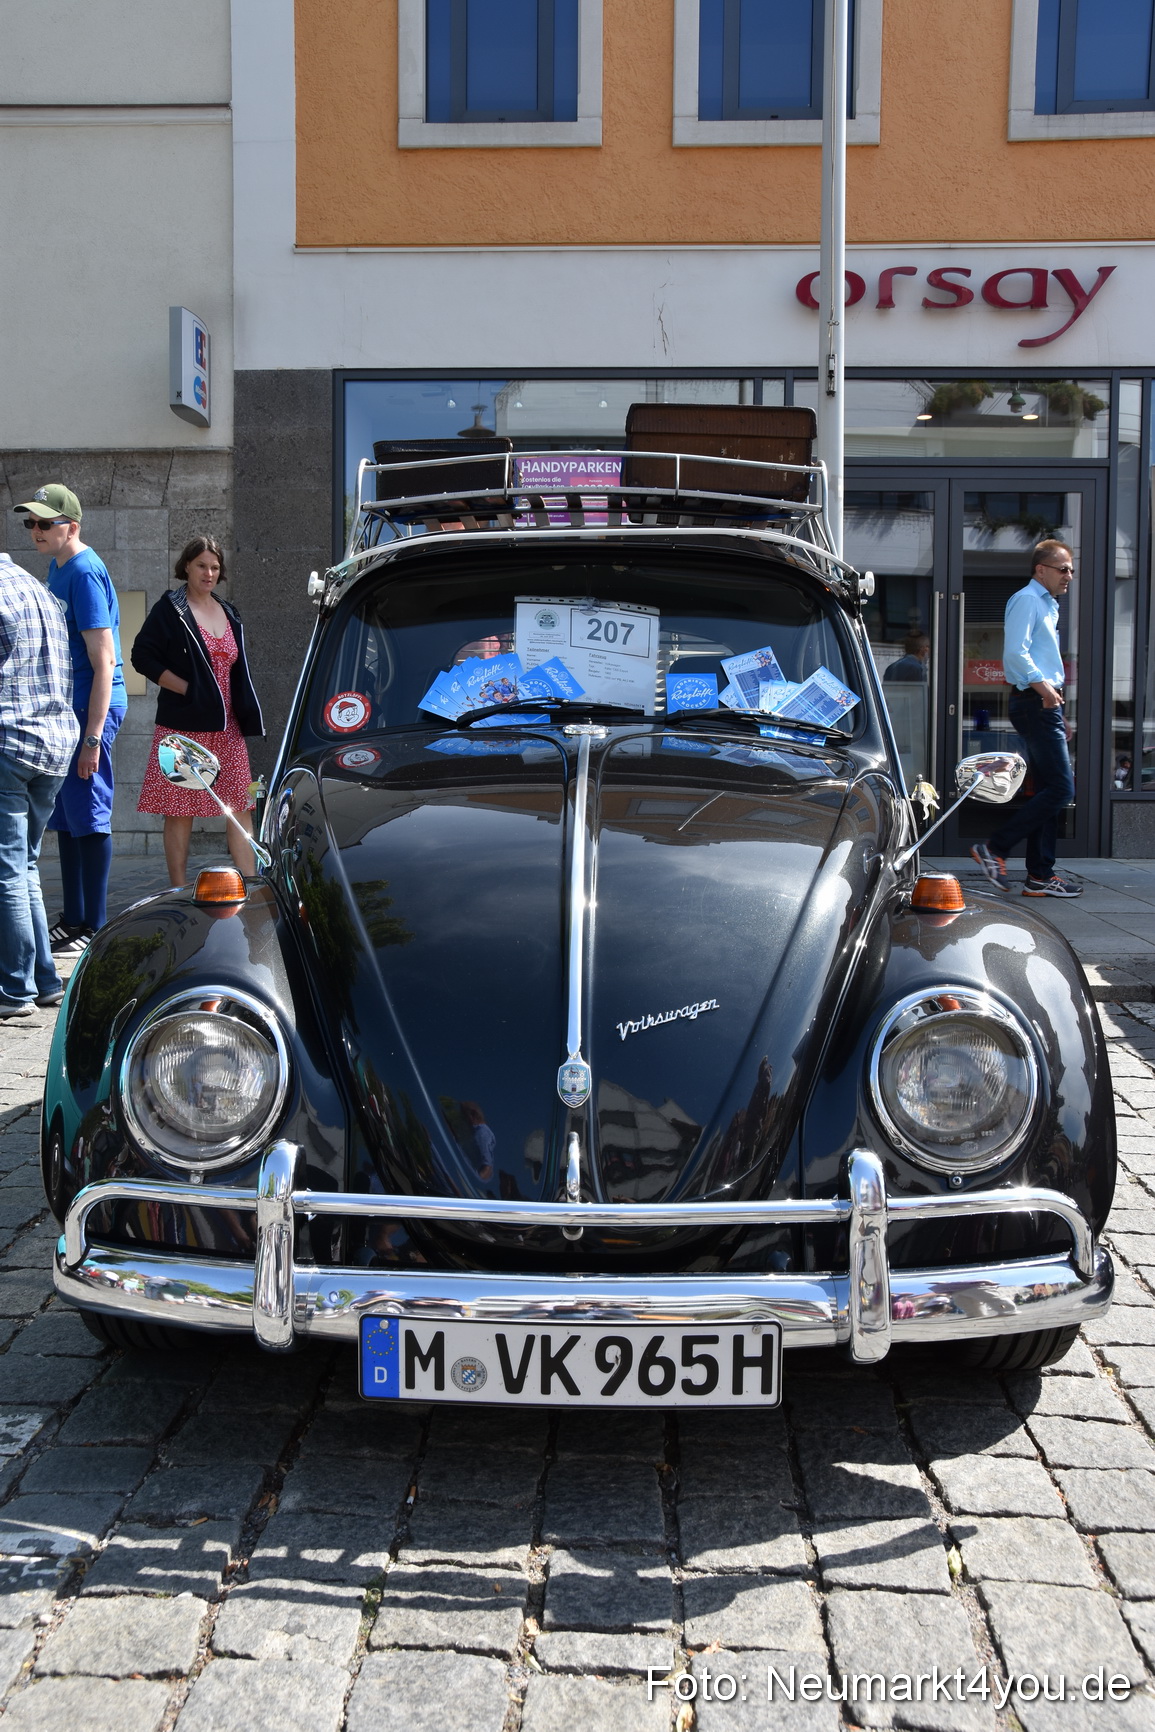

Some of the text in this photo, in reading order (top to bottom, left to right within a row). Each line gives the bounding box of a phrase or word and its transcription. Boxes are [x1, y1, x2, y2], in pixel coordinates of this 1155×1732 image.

[796, 265, 1117, 348] orsay
[521, 461, 622, 473] HANDYPARKEN
[586, 618, 635, 646] 207
[616, 998, 720, 1041] Volkswagen
[374, 1367, 388, 1384] D
[404, 1329, 445, 1391] M
